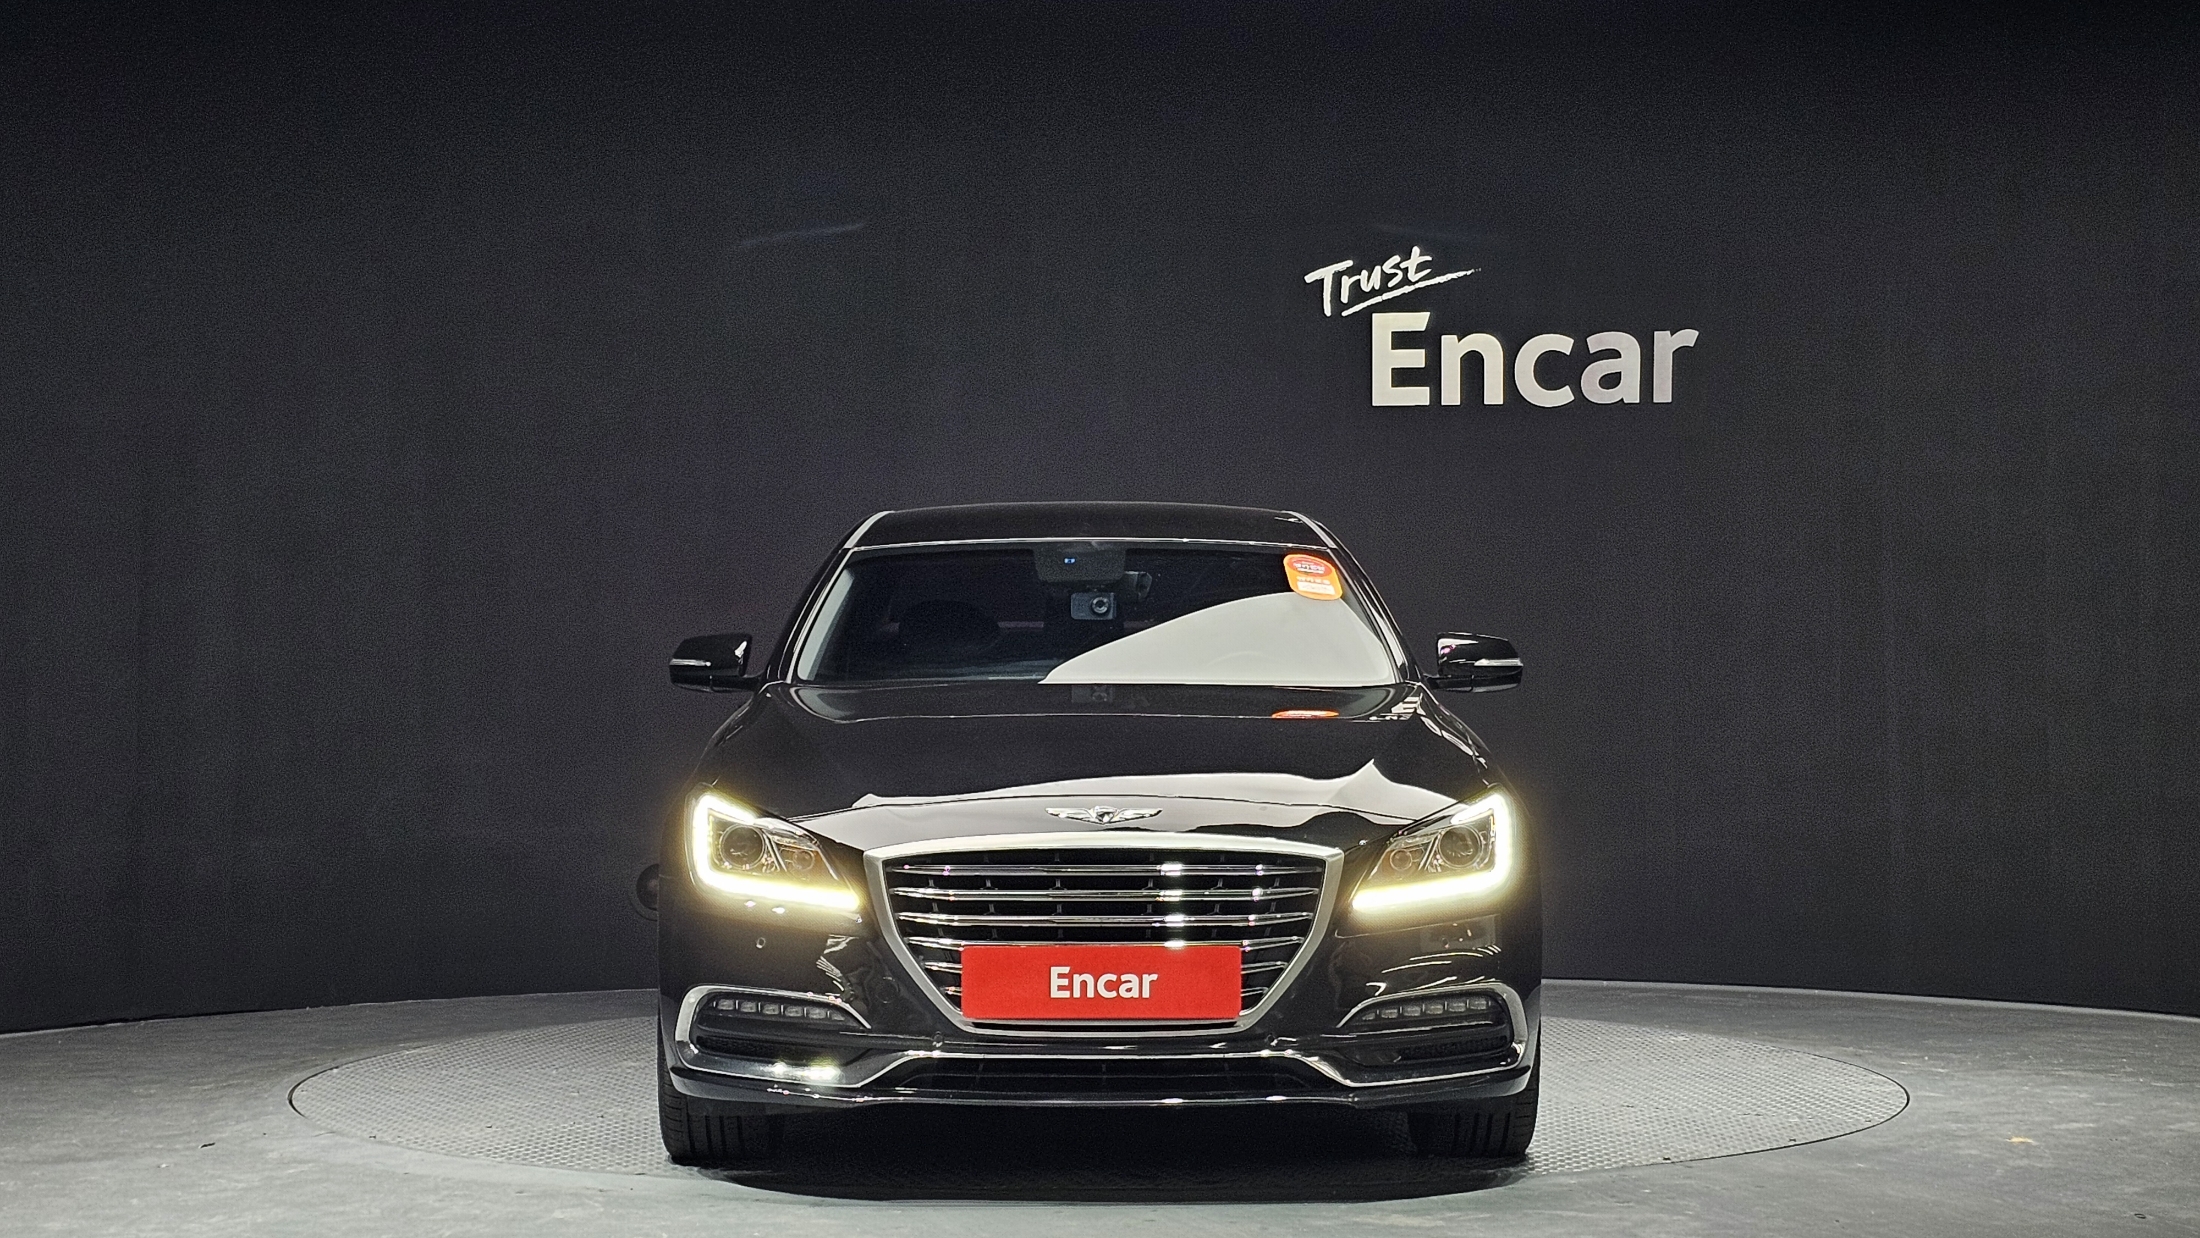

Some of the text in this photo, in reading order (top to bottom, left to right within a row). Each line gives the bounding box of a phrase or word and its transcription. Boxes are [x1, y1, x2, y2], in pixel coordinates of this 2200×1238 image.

[1304, 245, 1433, 317] Trust
[1371, 311, 1700, 408] Encar
[1049, 966, 1159, 999] Encar
